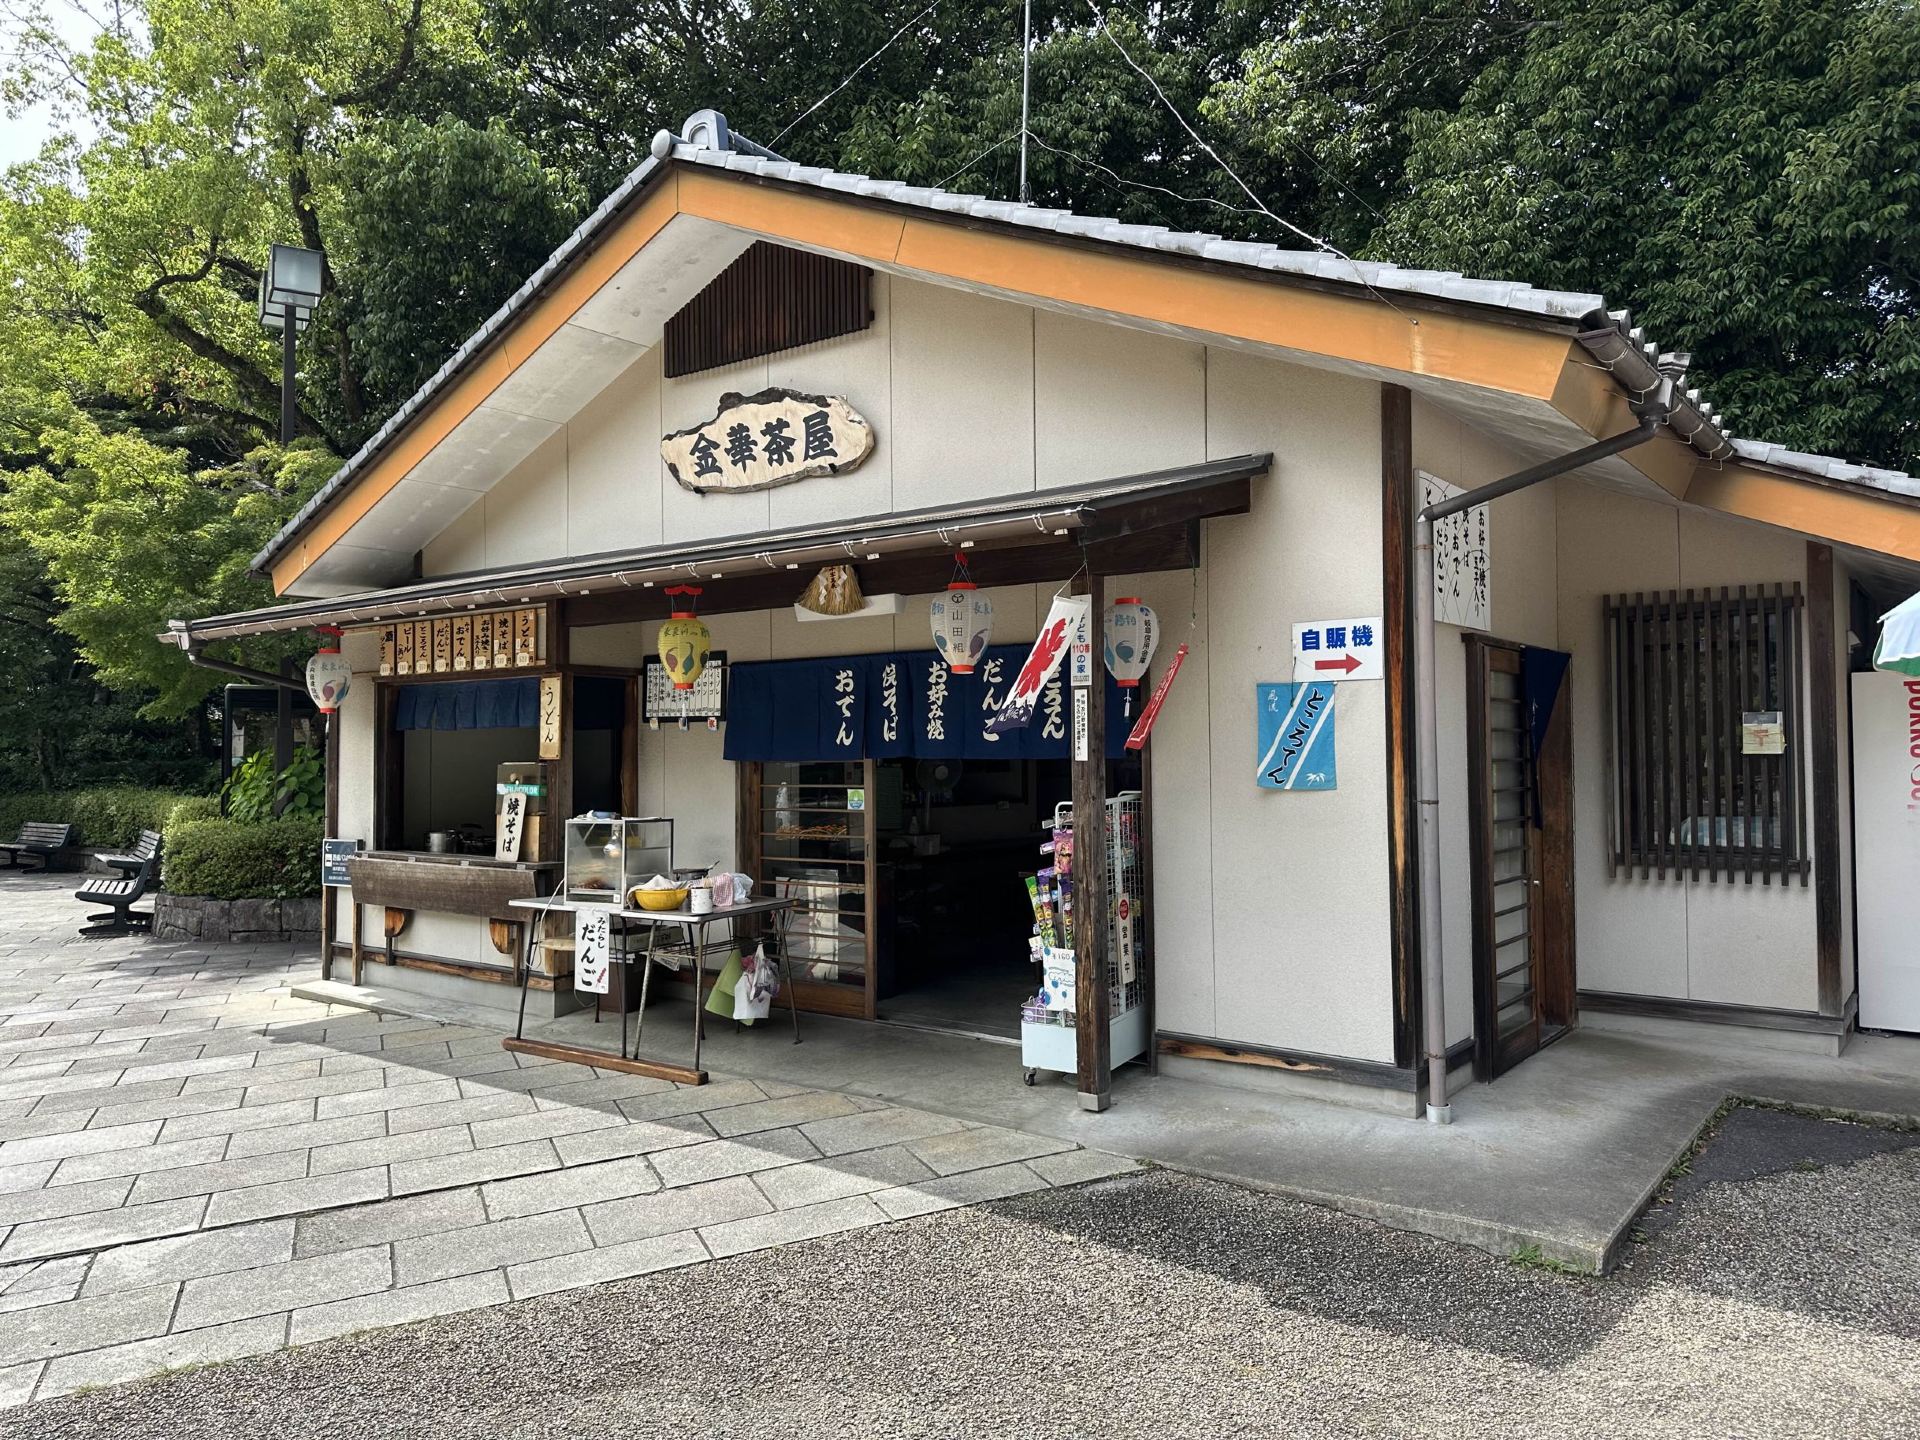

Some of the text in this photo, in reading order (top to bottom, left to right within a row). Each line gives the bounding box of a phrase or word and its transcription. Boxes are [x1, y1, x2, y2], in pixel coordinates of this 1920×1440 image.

[689, 409, 839, 478] 金華茶屋
[403, 627, 412, 653] ビール
[419, 626, 427, 658] ところてん
[436, 627, 445, 658] だんご
[456, 626, 465, 657] おでん
[498, 618, 509, 651] 焼そば
[520, 615, 530, 649] うどん
[952, 609, 964, 653] 山田組
[1301, 624, 1373, 651] 自販機
[544, 686, 557, 743] うどん
[834, 669, 855, 746] おでん
[882, 662, 899, 742] 焼そば
[926, 660, 949, 740] お好み焼
[1267, 688, 1325, 785] ところてん
[502, 797, 519, 853] 焼そば
[580, 922, 597, 987] だんご
[597, 917, 606, 949] みたらし
